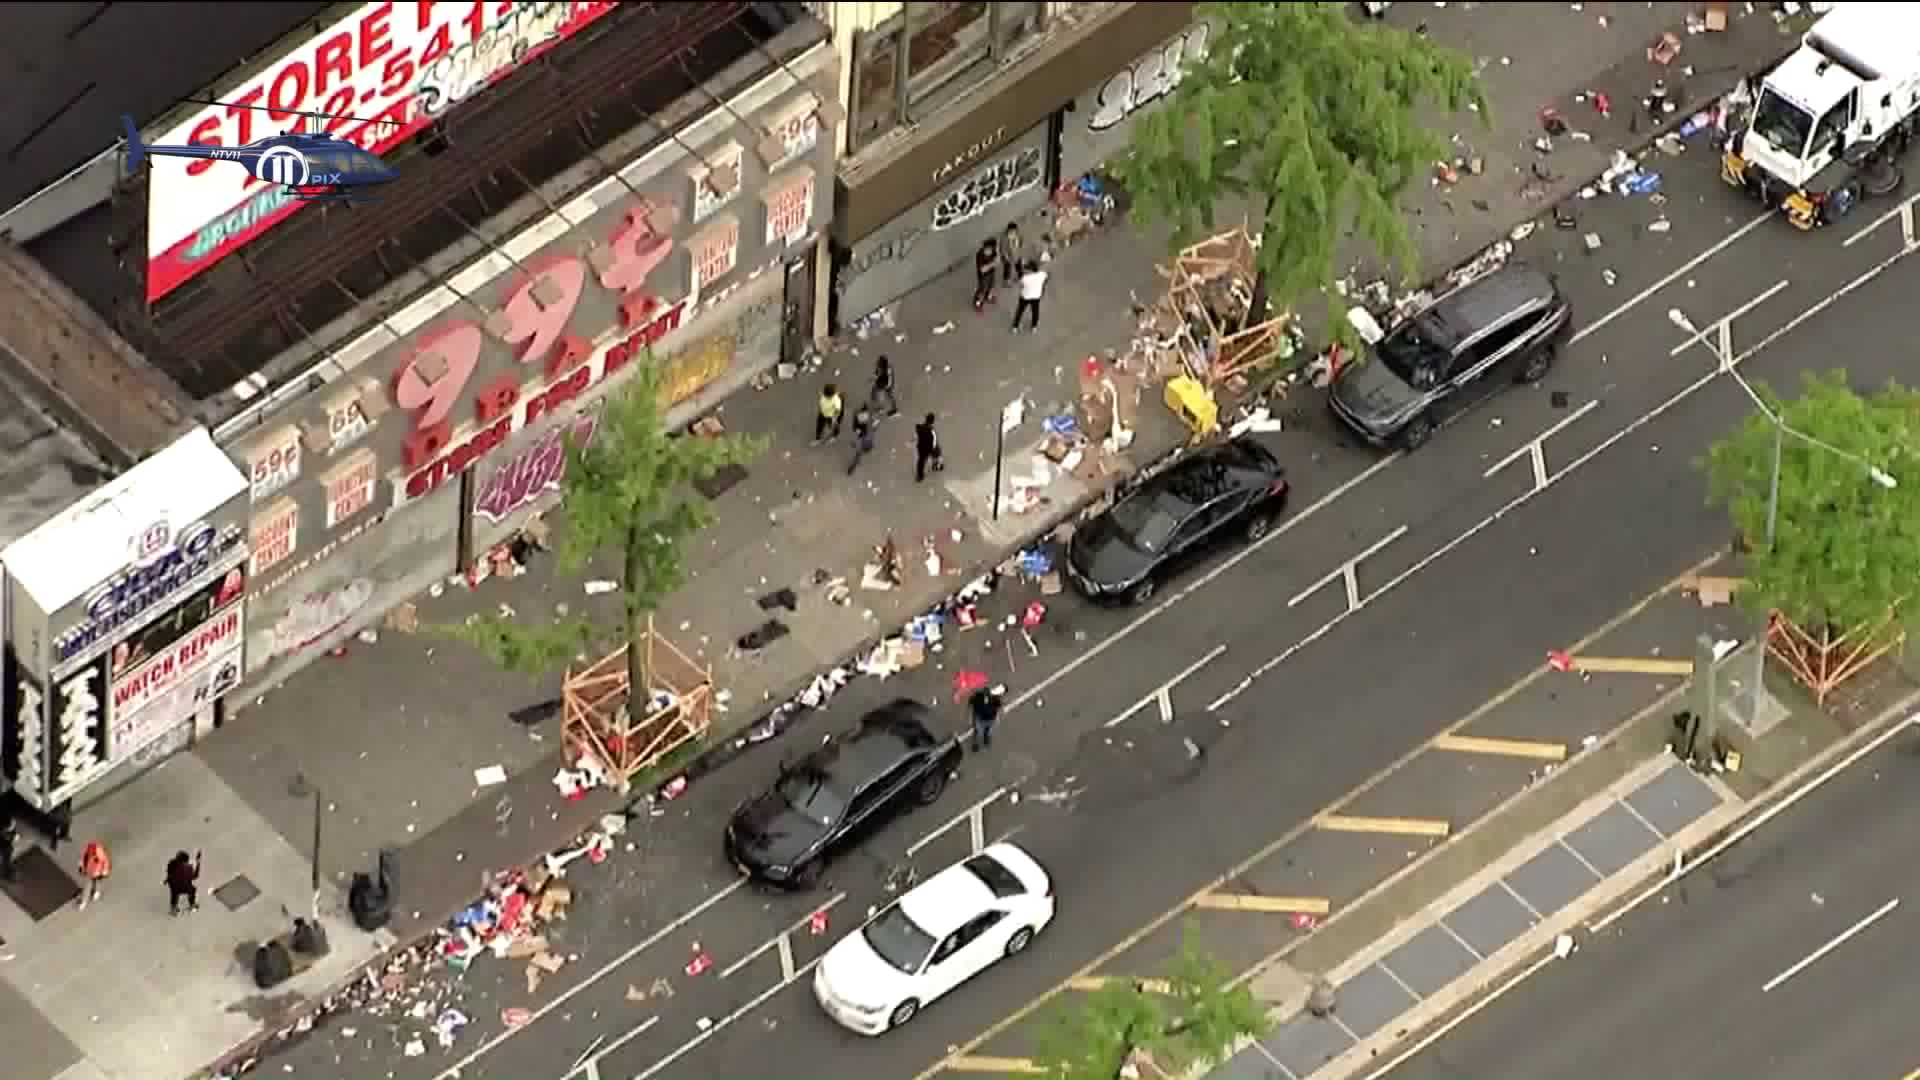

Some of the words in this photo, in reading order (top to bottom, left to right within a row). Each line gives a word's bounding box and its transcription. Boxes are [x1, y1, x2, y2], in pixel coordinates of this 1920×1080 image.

[186, 3, 394, 177] STORE
[113, 652, 174, 707] WATCH
[178, 611, 239, 666] REPAIR
